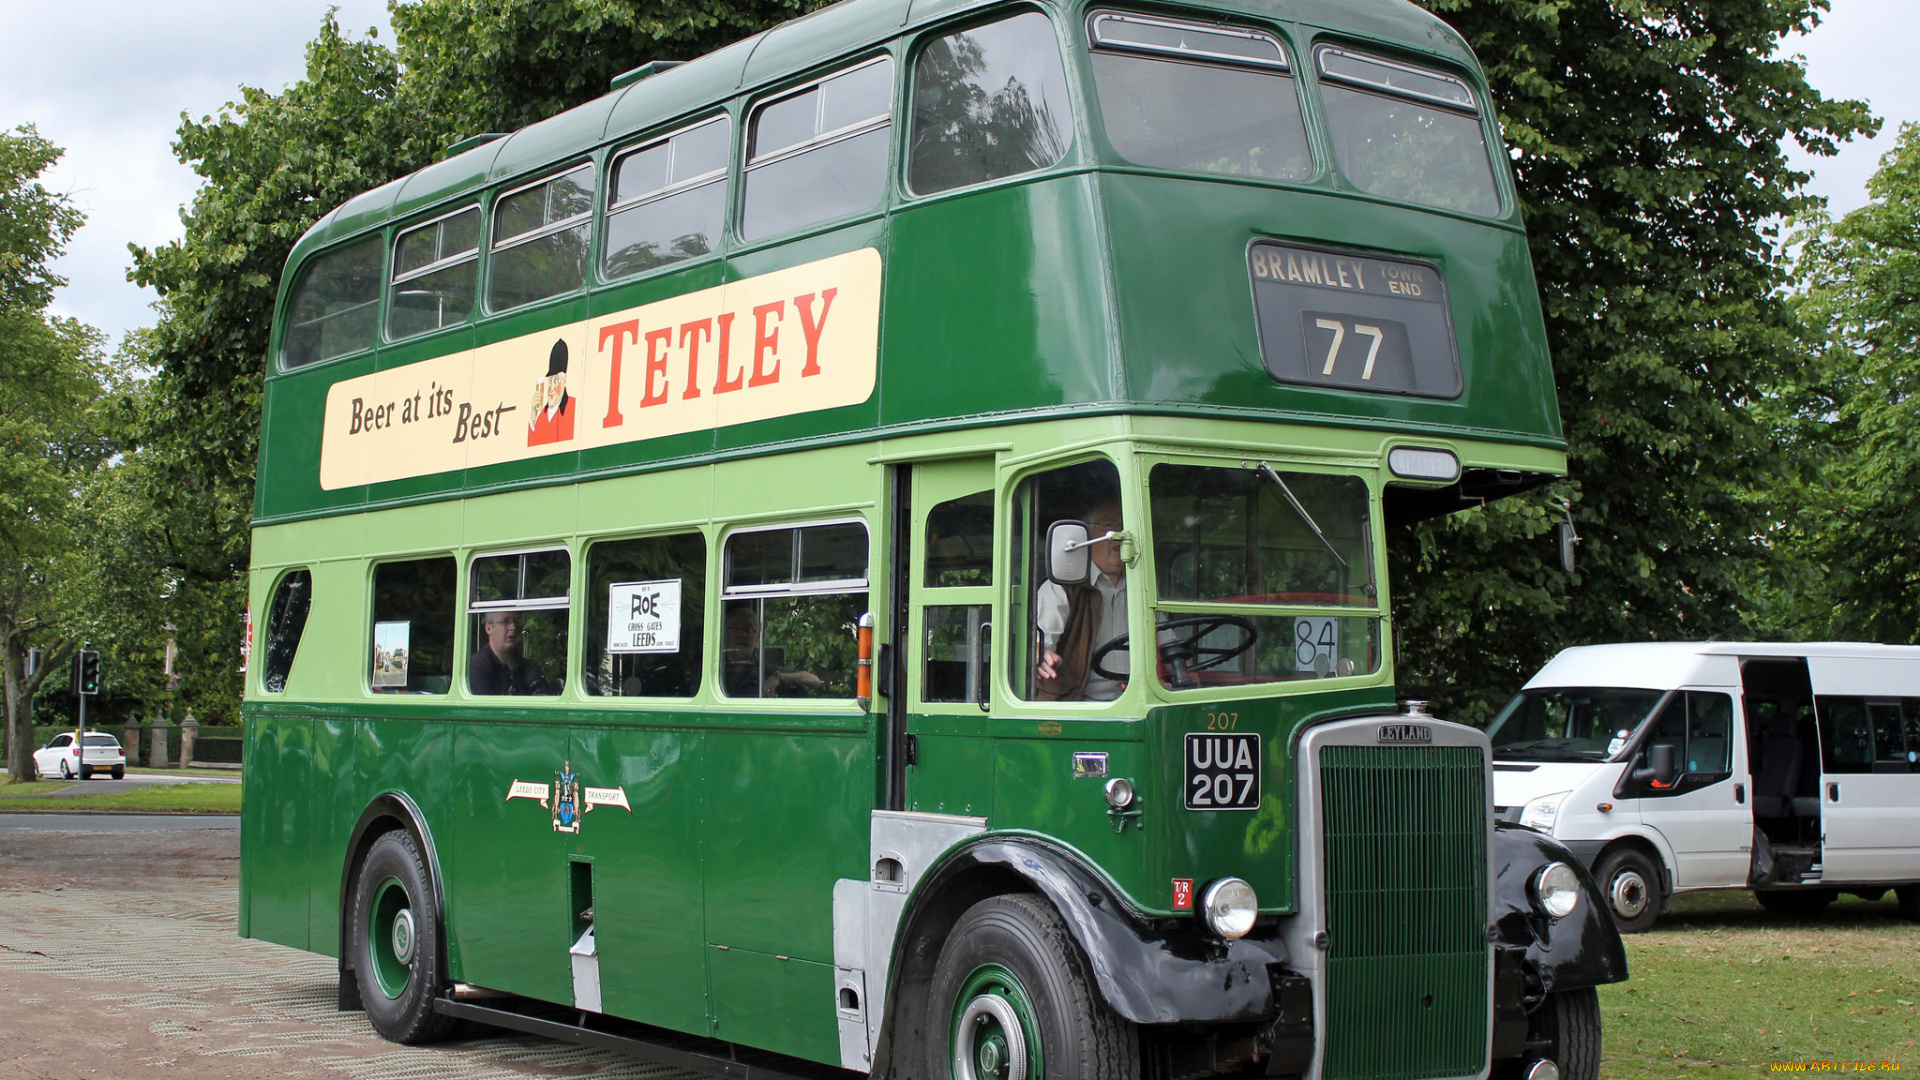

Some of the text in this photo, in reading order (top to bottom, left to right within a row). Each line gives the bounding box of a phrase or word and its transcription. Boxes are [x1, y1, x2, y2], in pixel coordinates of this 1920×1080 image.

[1252, 250, 1424, 290] BRAMLEY TOWN
[1388, 280, 1422, 297] END
[597, 287, 838, 429] TETLEY
[1315, 318, 1384, 381] 77
[349, 380, 454, 436] Beer at its
[452, 401, 517, 444] Best
[631, 592, 660, 620] ROE
[627, 621, 663, 632] CROSS GATES
[632, 632, 656, 647] LEEDS
[1296, 620, 1336, 665] 84
[1207, 712, 1239, 731] 207
[1380, 725, 1431, 740] LEYLAND
[1192, 738, 1254, 770] UUA
[516, 785, 621, 801] LEEDS CITY TRANSPORT
[1192, 773, 1255, 805] 207
[1174, 881, 1189, 893] T/R
[1177, 893, 1186, 905] 2
